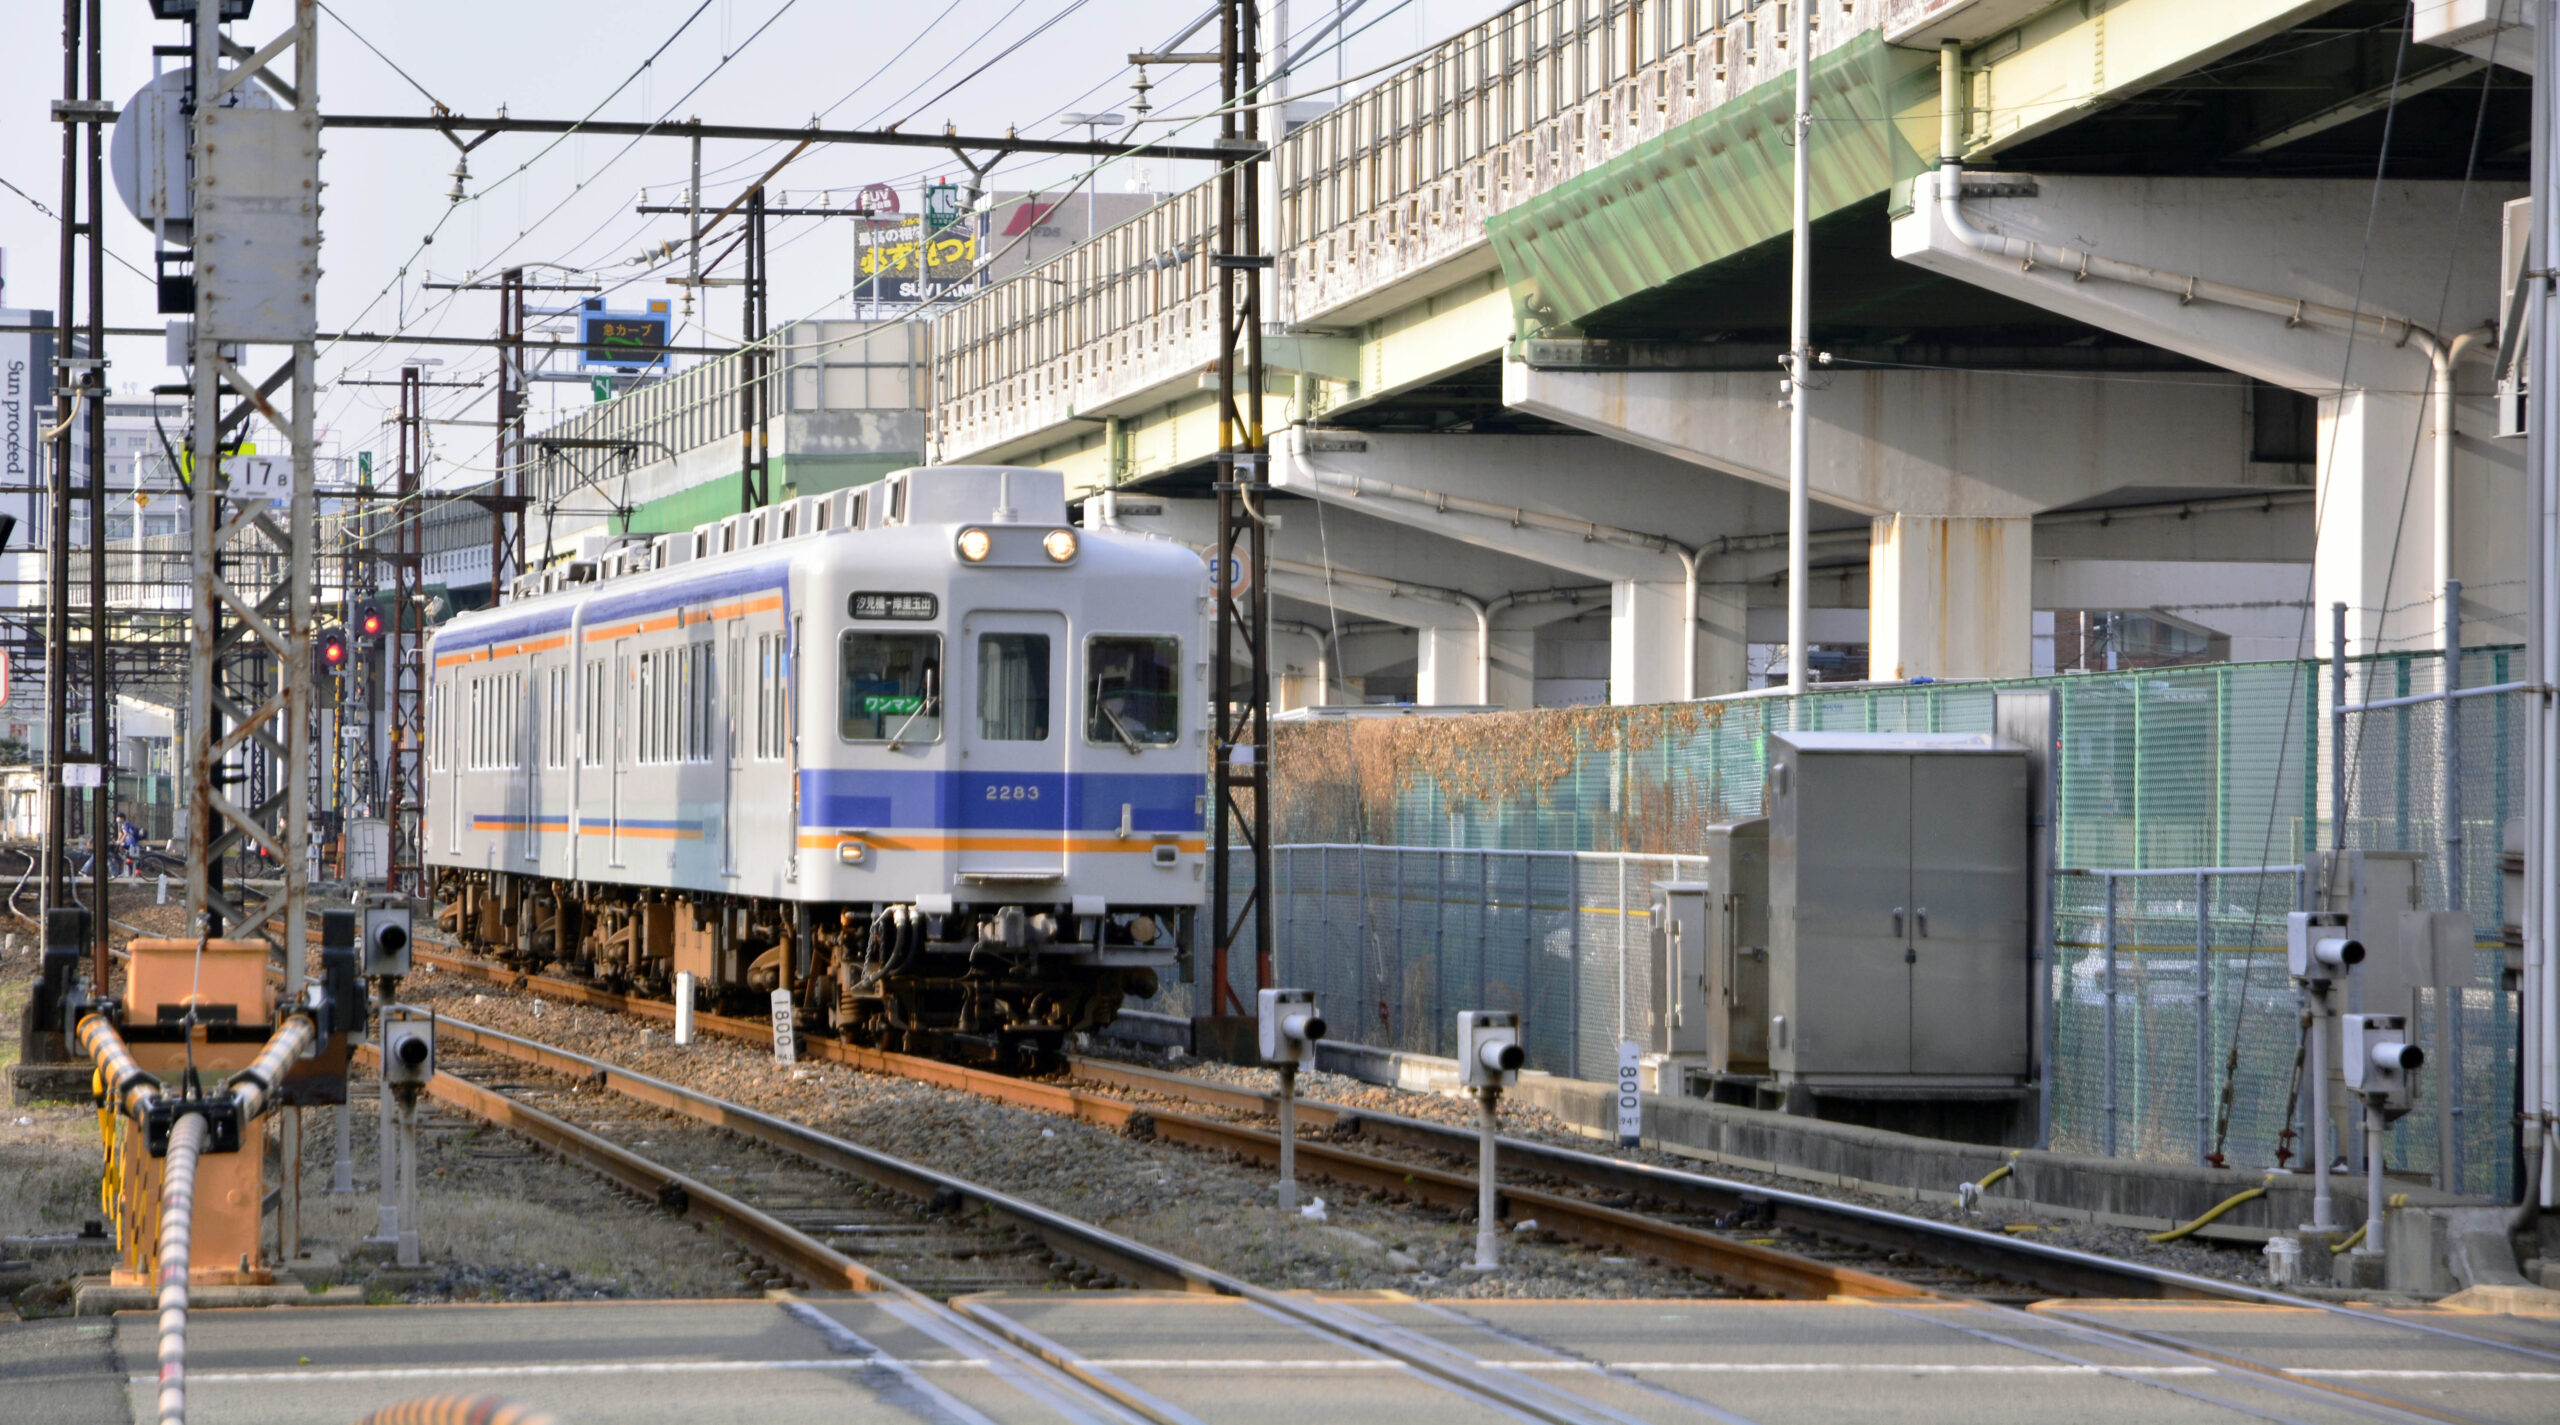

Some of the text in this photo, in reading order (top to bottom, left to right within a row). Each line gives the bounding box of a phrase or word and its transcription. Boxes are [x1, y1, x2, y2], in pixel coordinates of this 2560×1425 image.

[2, 360, 24, 475] Sun proceed
[866, 697, 919, 711] ワンマン
[986, 785, 1039, 800] 2283
